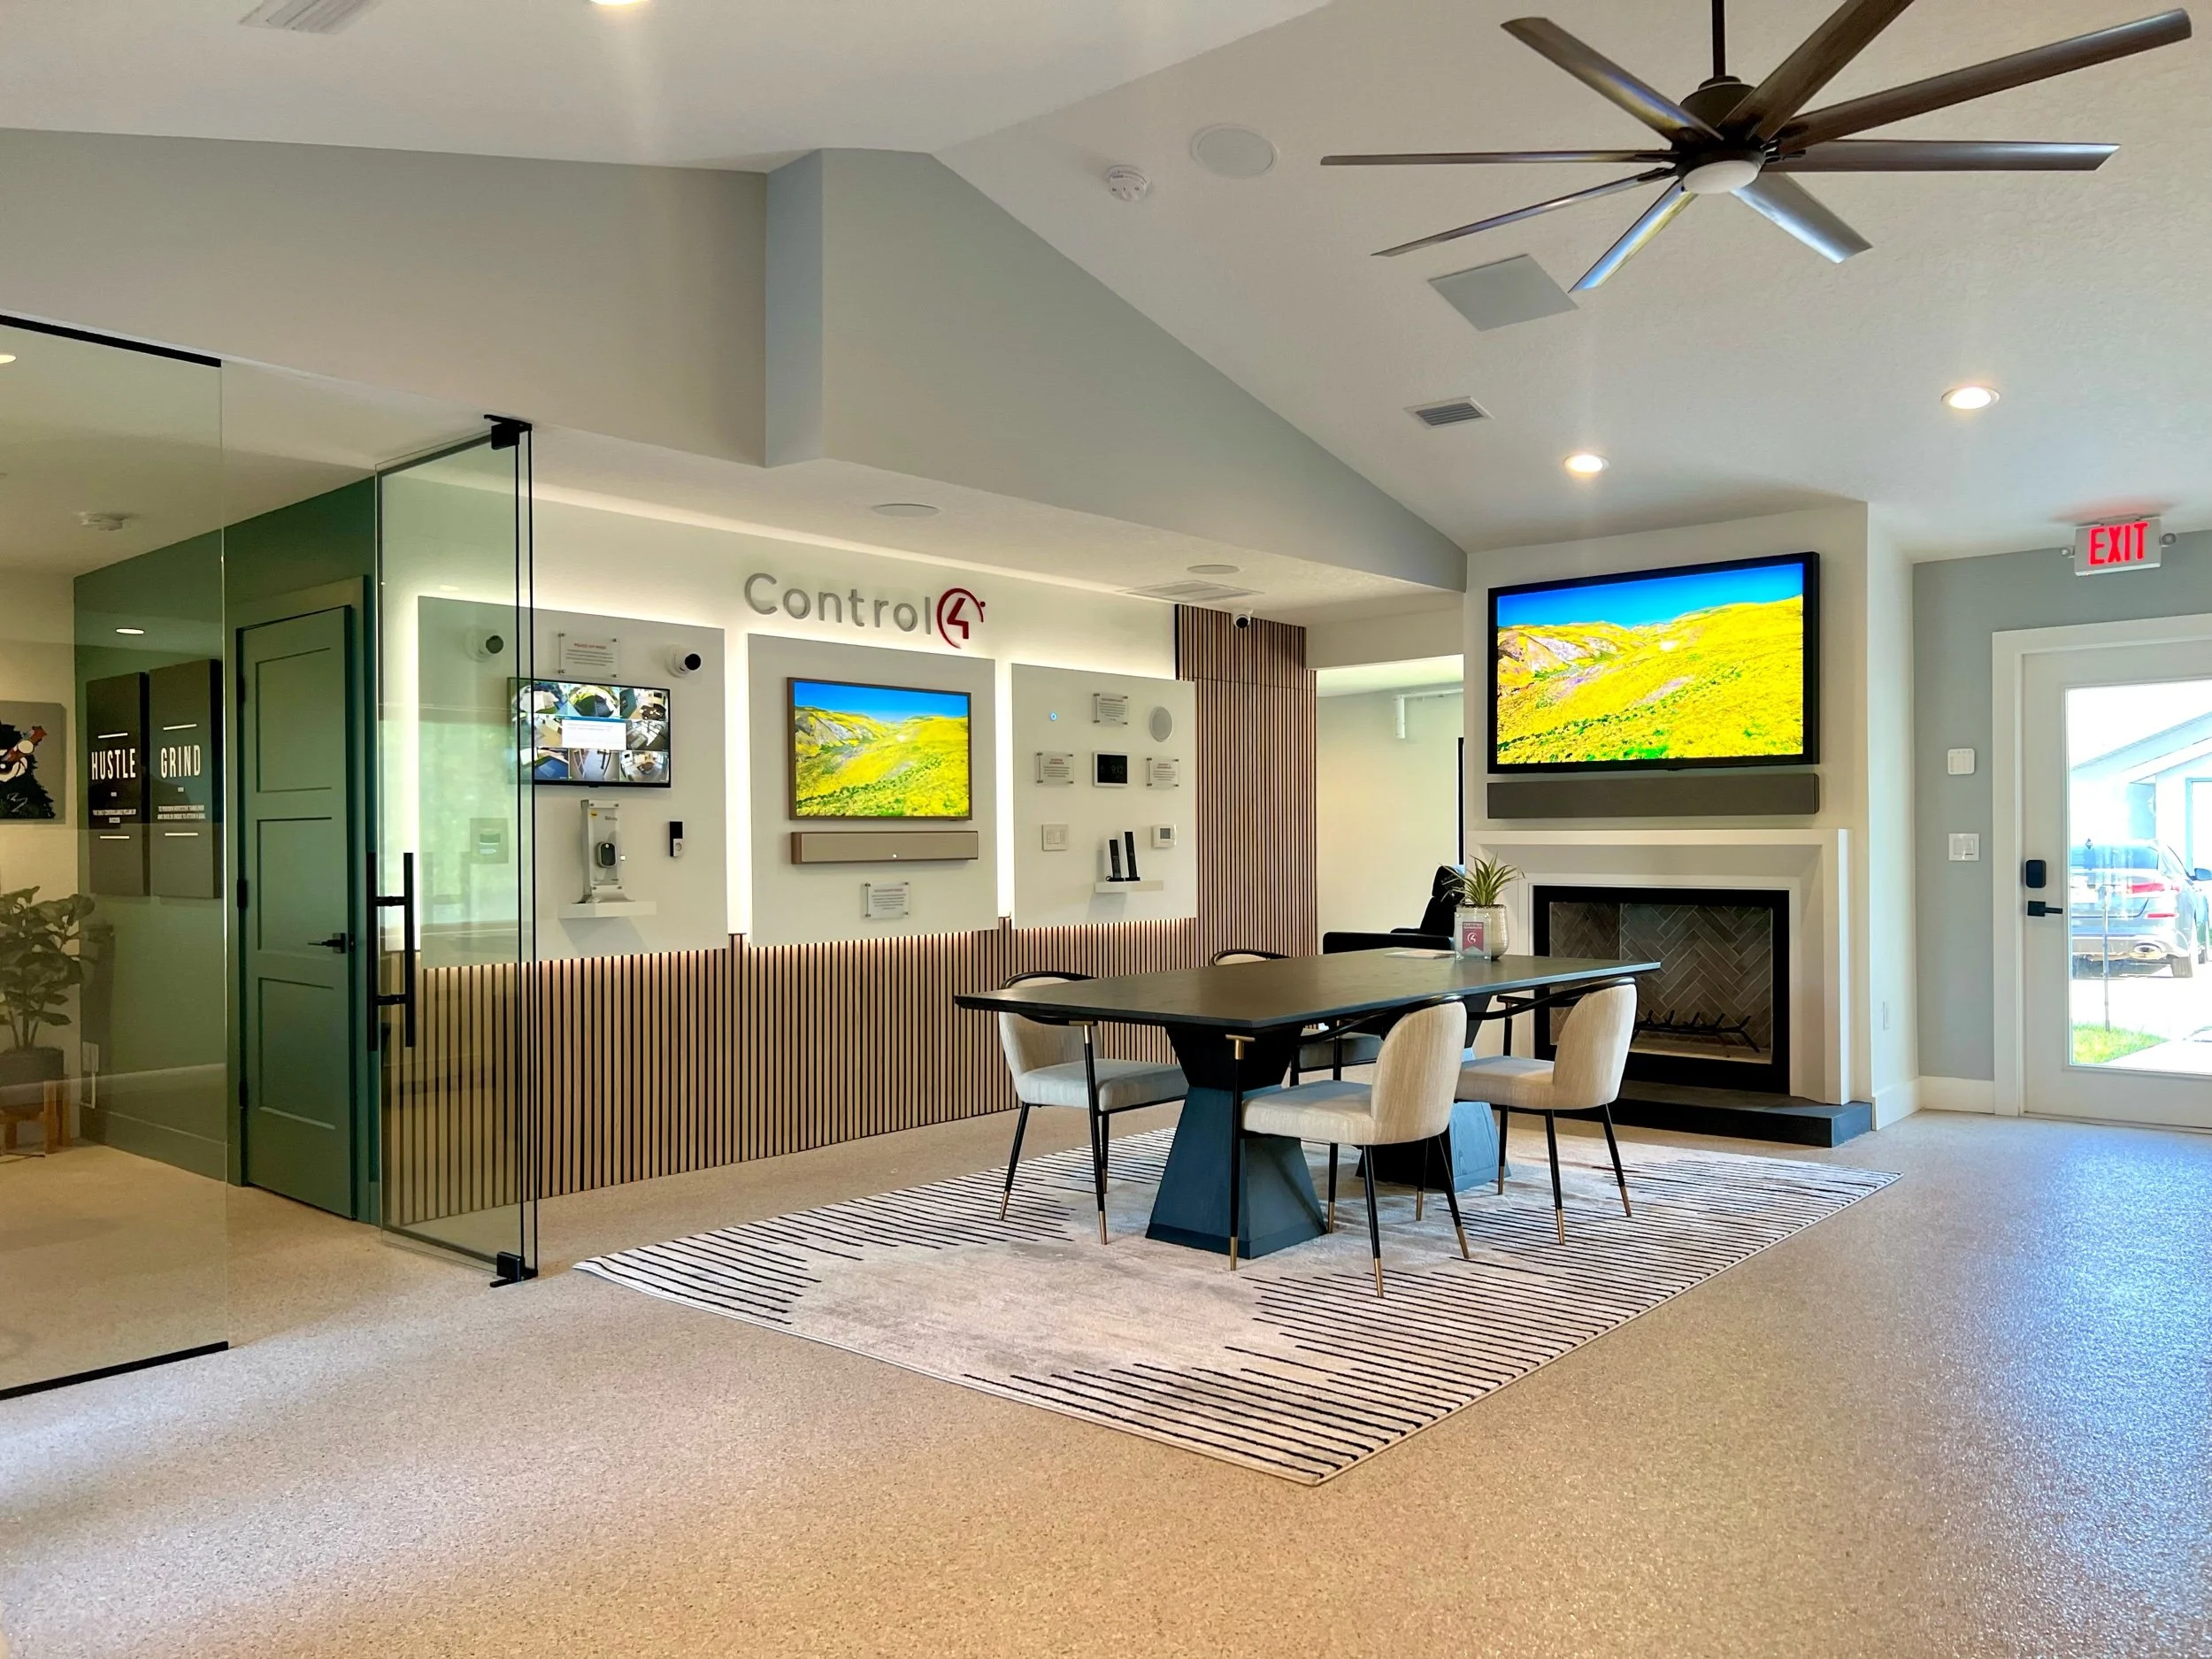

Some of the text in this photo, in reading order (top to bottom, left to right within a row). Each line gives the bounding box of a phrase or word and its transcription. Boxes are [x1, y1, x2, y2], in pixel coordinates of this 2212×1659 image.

[2089, 520, 2150, 566] EXIT
[91, 748, 136, 780] HUSTLE
[160, 744, 201, 779] GRIND
